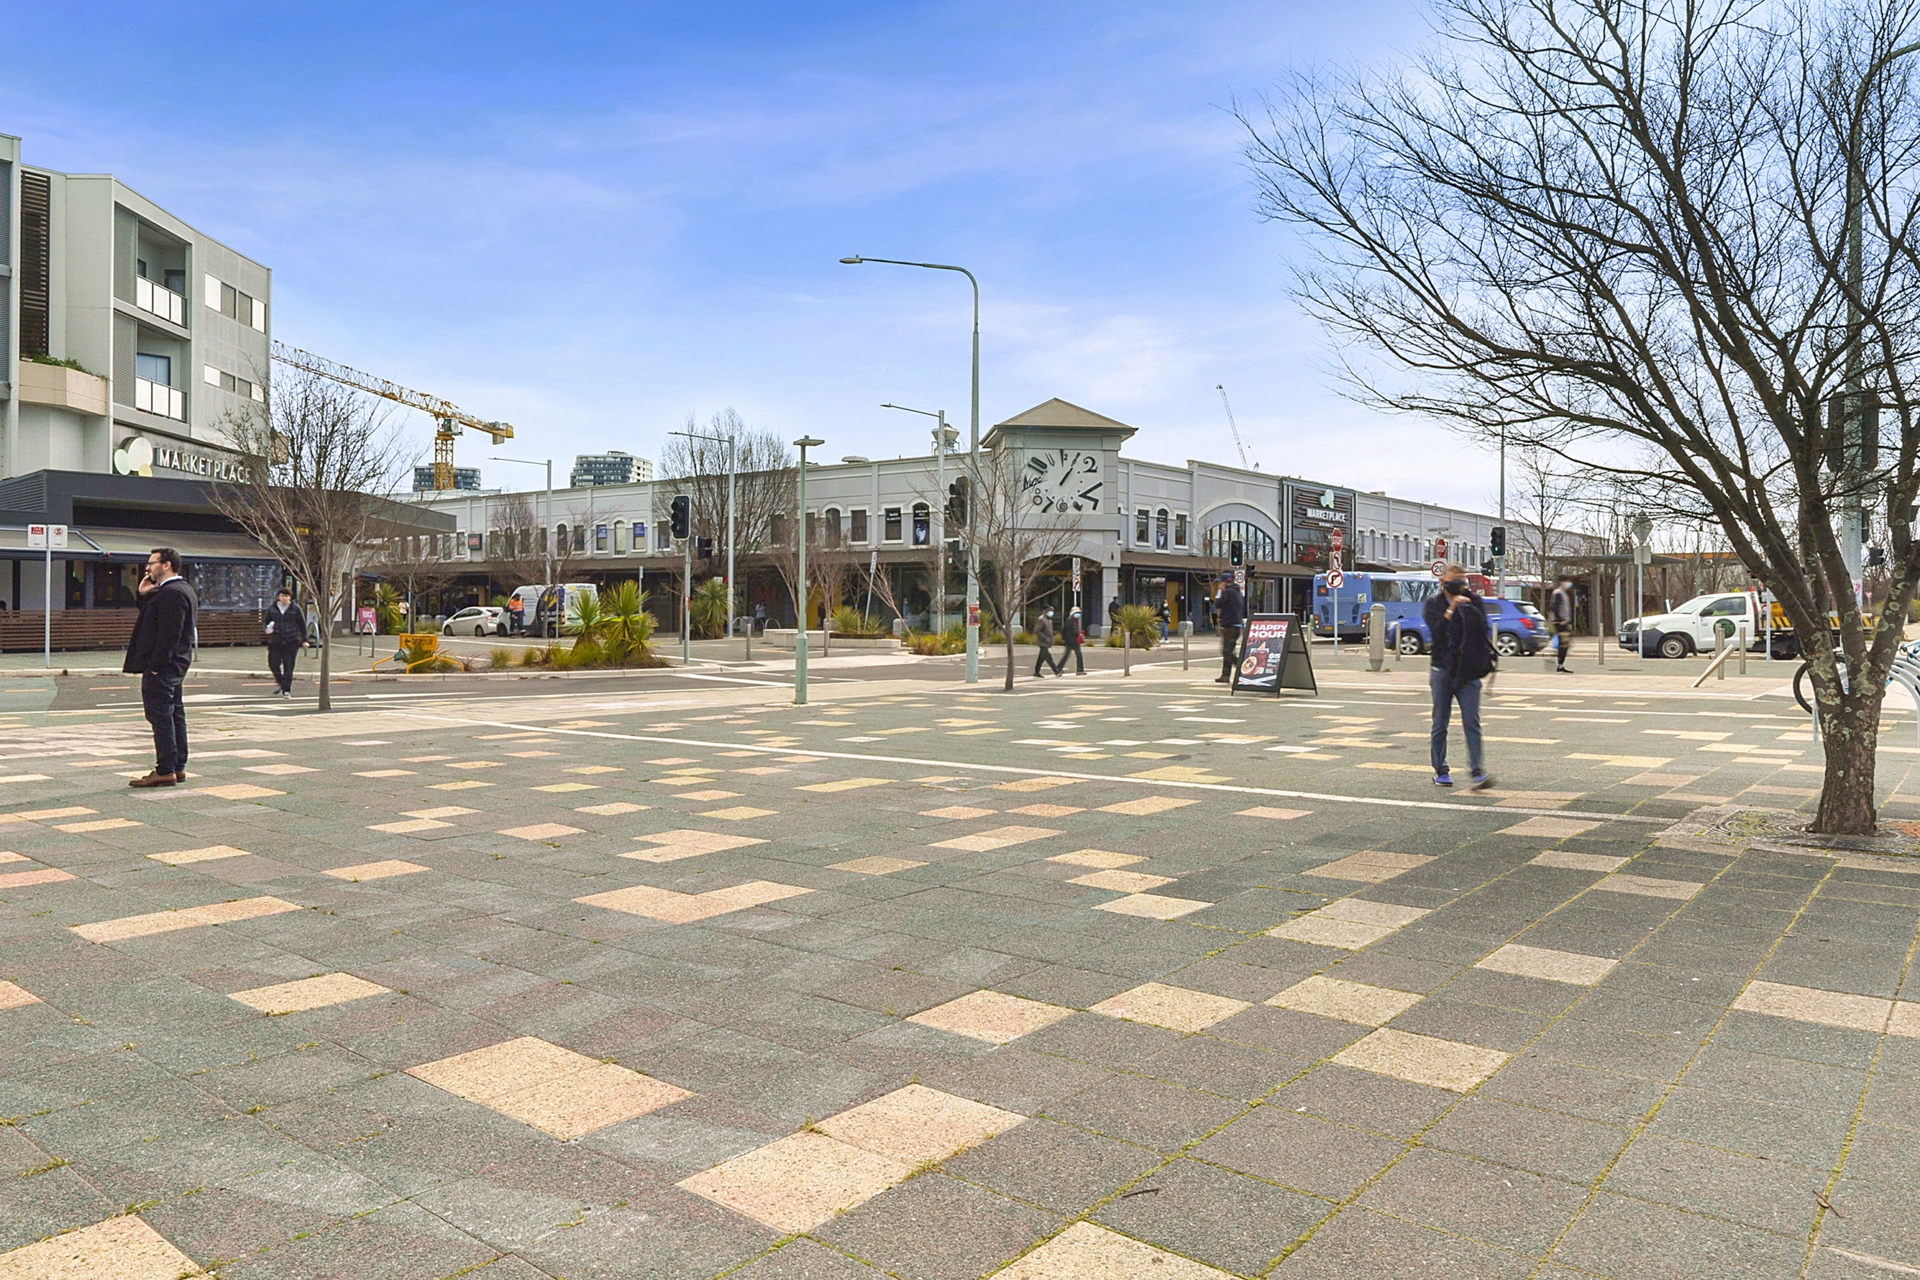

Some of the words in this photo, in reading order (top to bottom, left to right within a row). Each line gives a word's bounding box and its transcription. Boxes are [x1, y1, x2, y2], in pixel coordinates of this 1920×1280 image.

[158, 447, 251, 485] MARKETPLACE
[1083, 456, 1099, 473] 2
[1306, 507, 1346, 523] MARKETPLACE
[1434, 565, 1444, 573] 20
